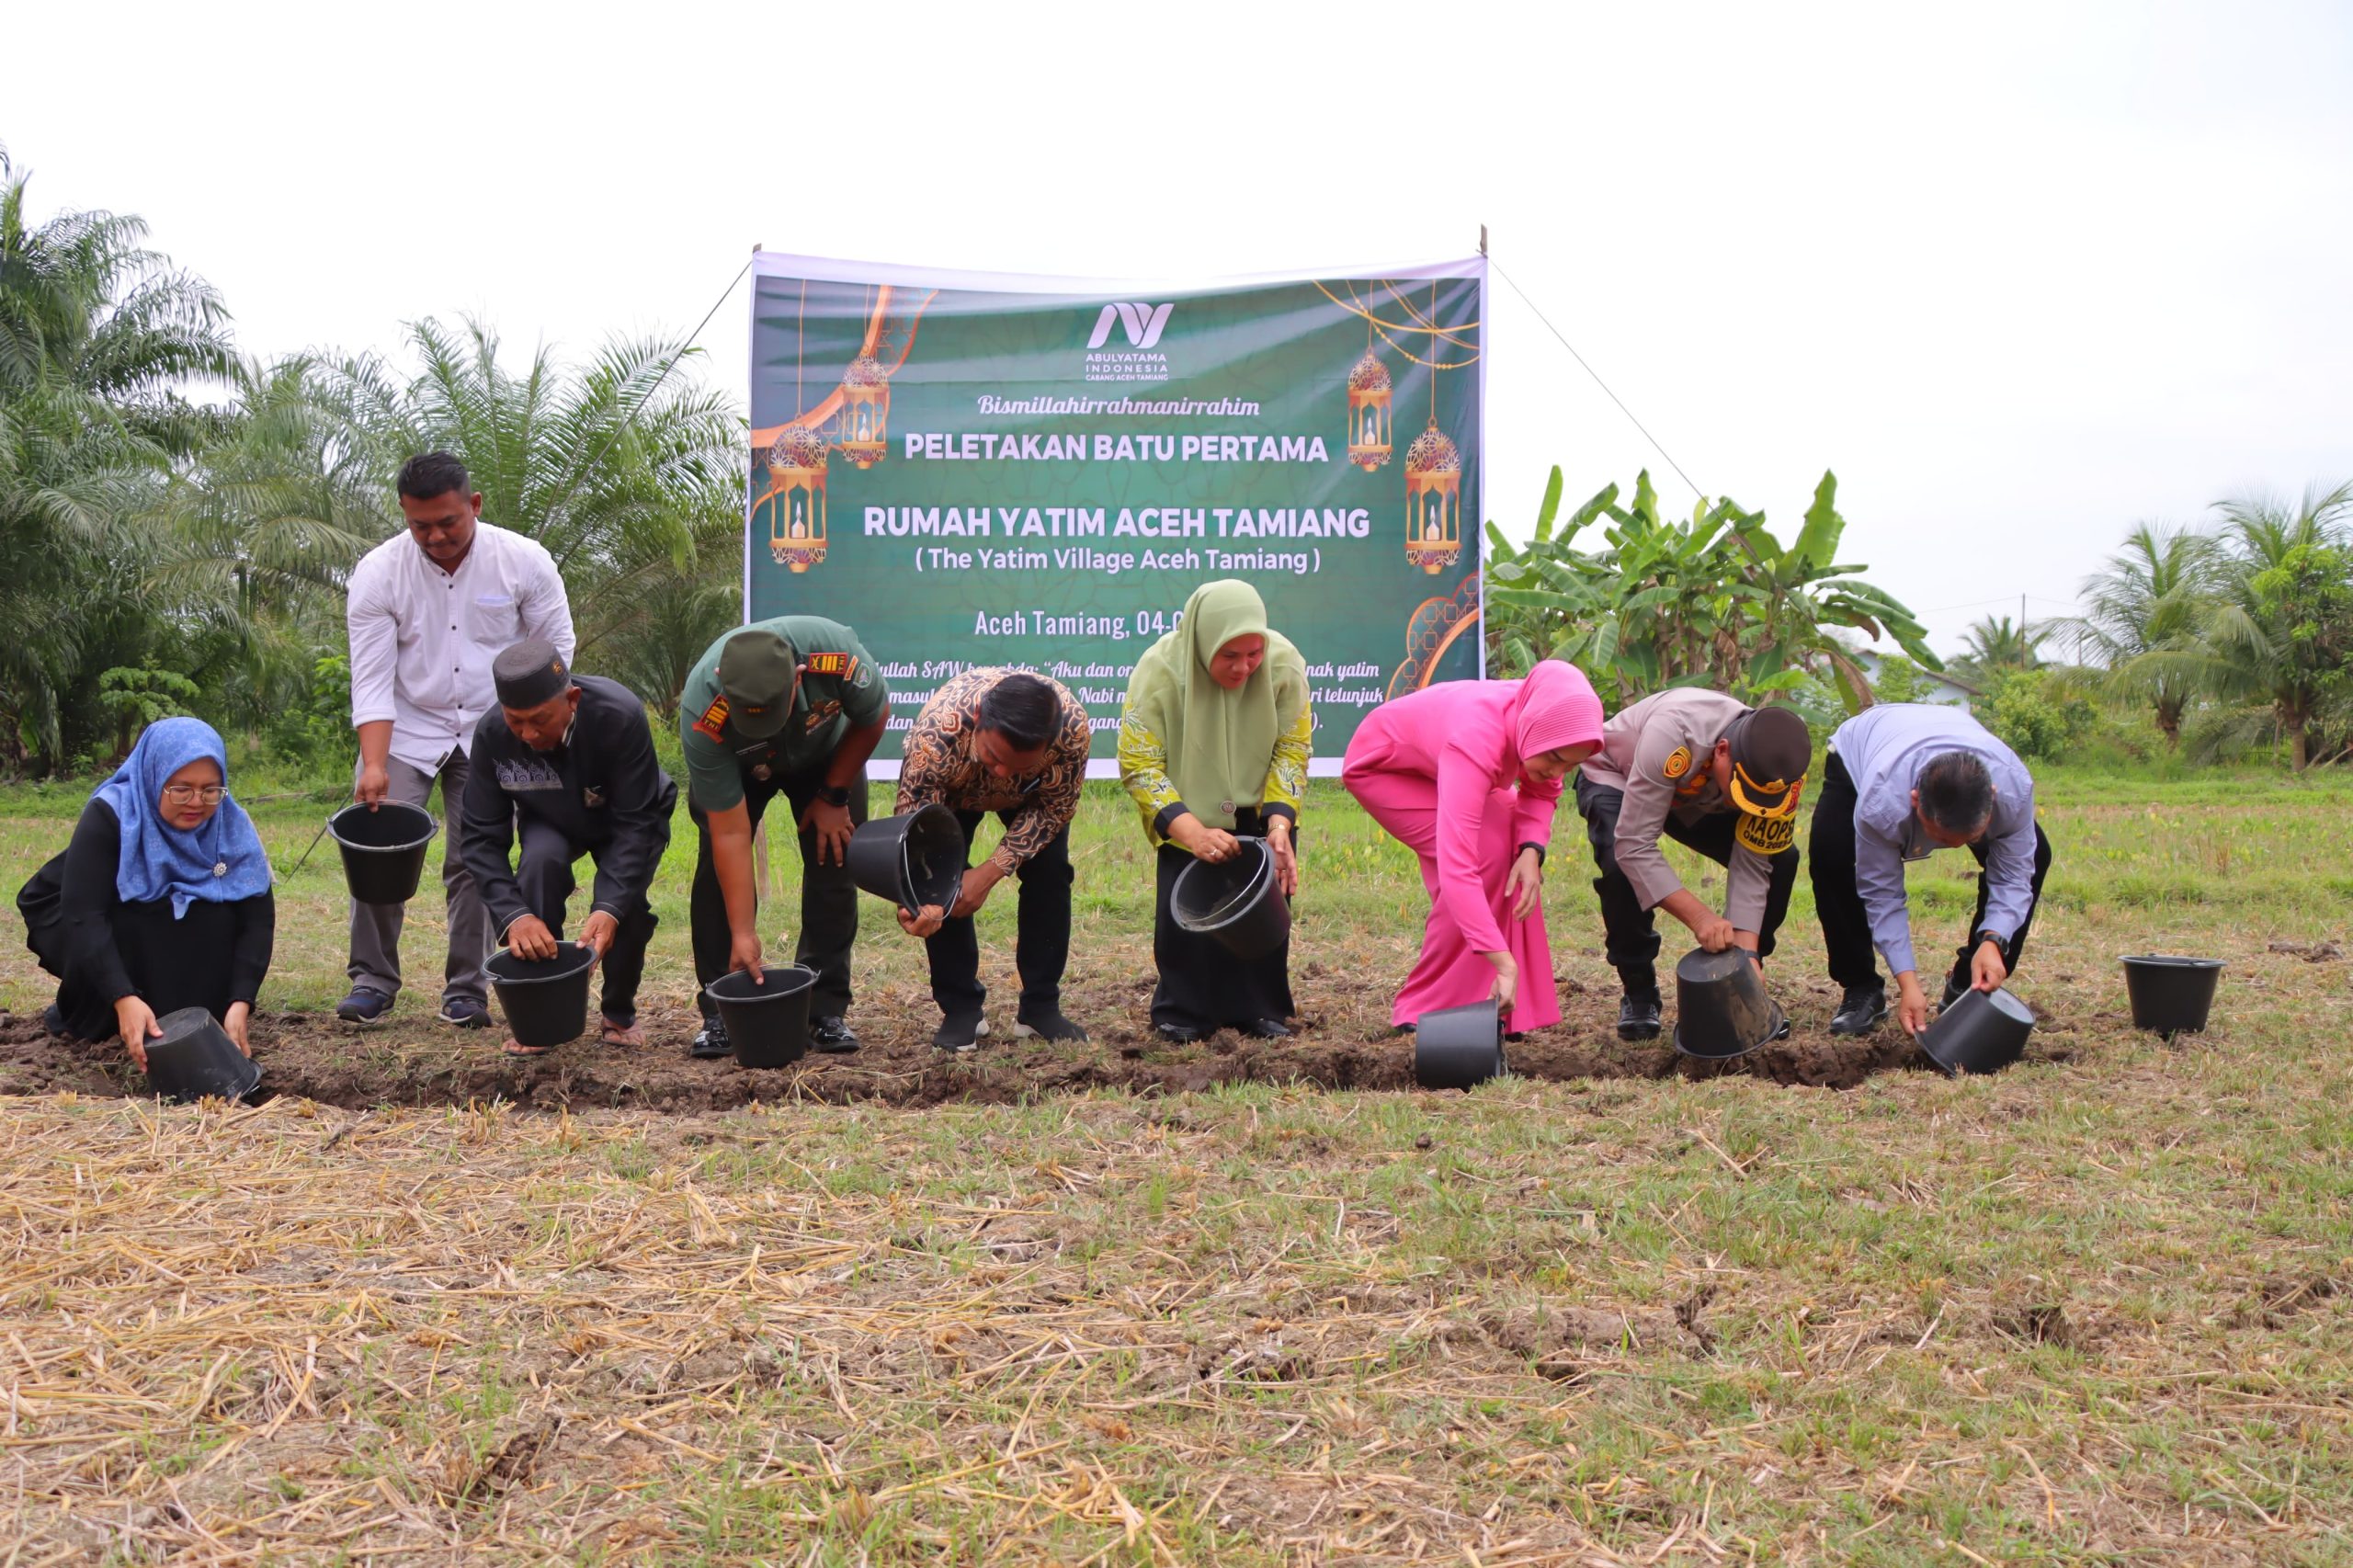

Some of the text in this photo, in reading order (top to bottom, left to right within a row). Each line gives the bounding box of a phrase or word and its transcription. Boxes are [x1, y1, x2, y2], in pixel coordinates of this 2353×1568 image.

[1086, 353, 1167, 362] ABULYATAMA
[1086, 364, 1168, 372] INDONESIA
[977, 394, 1260, 416] Bismillahirrahmanirrahim
[905, 433, 1329, 462] PELETAKAN BATU PERTAMA
[864, 506, 1370, 538] RUMAH YATIM ACEH TAMIANG
[977, 546, 1048, 569] Yatim
[1053, 546, 1135, 574] Village
[1140, 547, 1199, 570] Aceh
[974, 610, 1184, 640] Aceh Tamiang, 04-0
[922, 660, 964, 679] SAW
[1085, 662, 1114, 677] dan
[1305, 662, 1334, 677] nak
[1337, 661, 1380, 681] yatim
[1078, 687, 1115, 703] Nabi
[1324, 687, 1383, 708] telunjuk
[885, 714, 915, 731] dan
